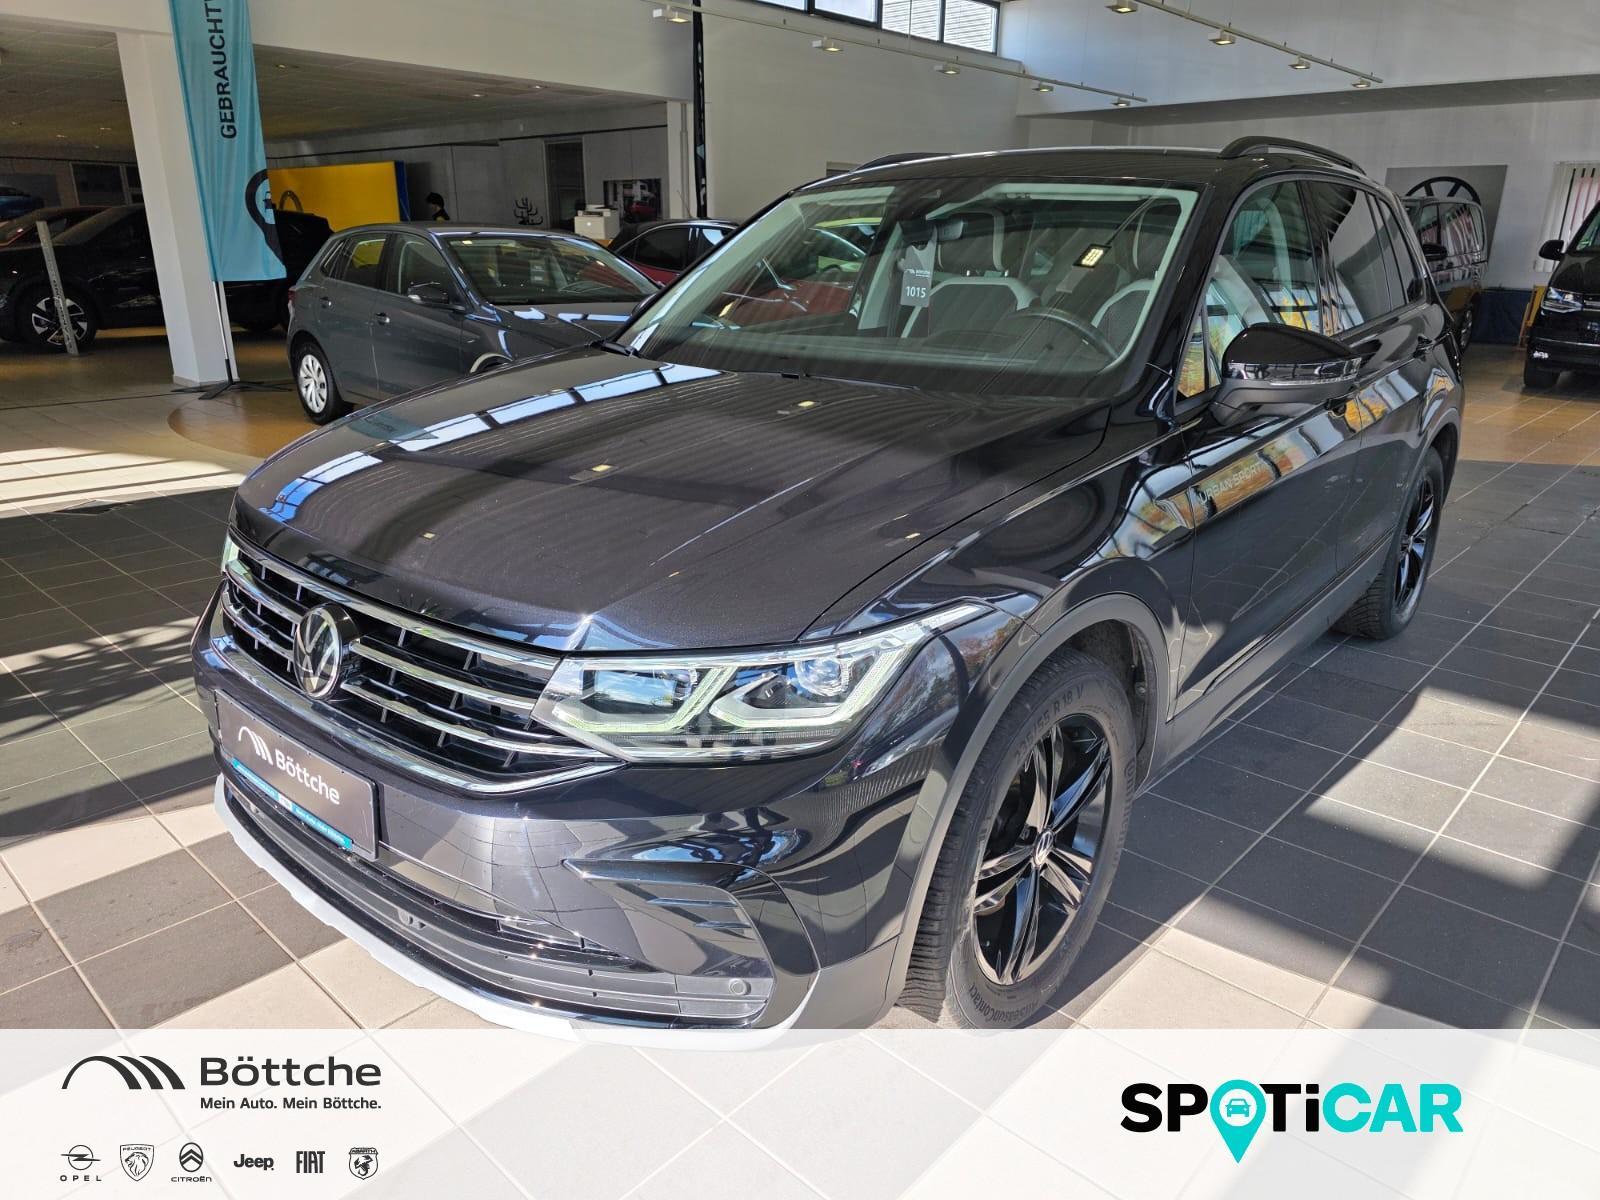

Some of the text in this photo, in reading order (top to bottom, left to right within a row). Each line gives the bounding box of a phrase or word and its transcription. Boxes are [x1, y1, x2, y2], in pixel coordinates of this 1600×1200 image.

[204, 0, 236, 138] GEBRAUCHT
[905, 286, 927, 298] 1015
[275, 749, 340, 805] Böttche
